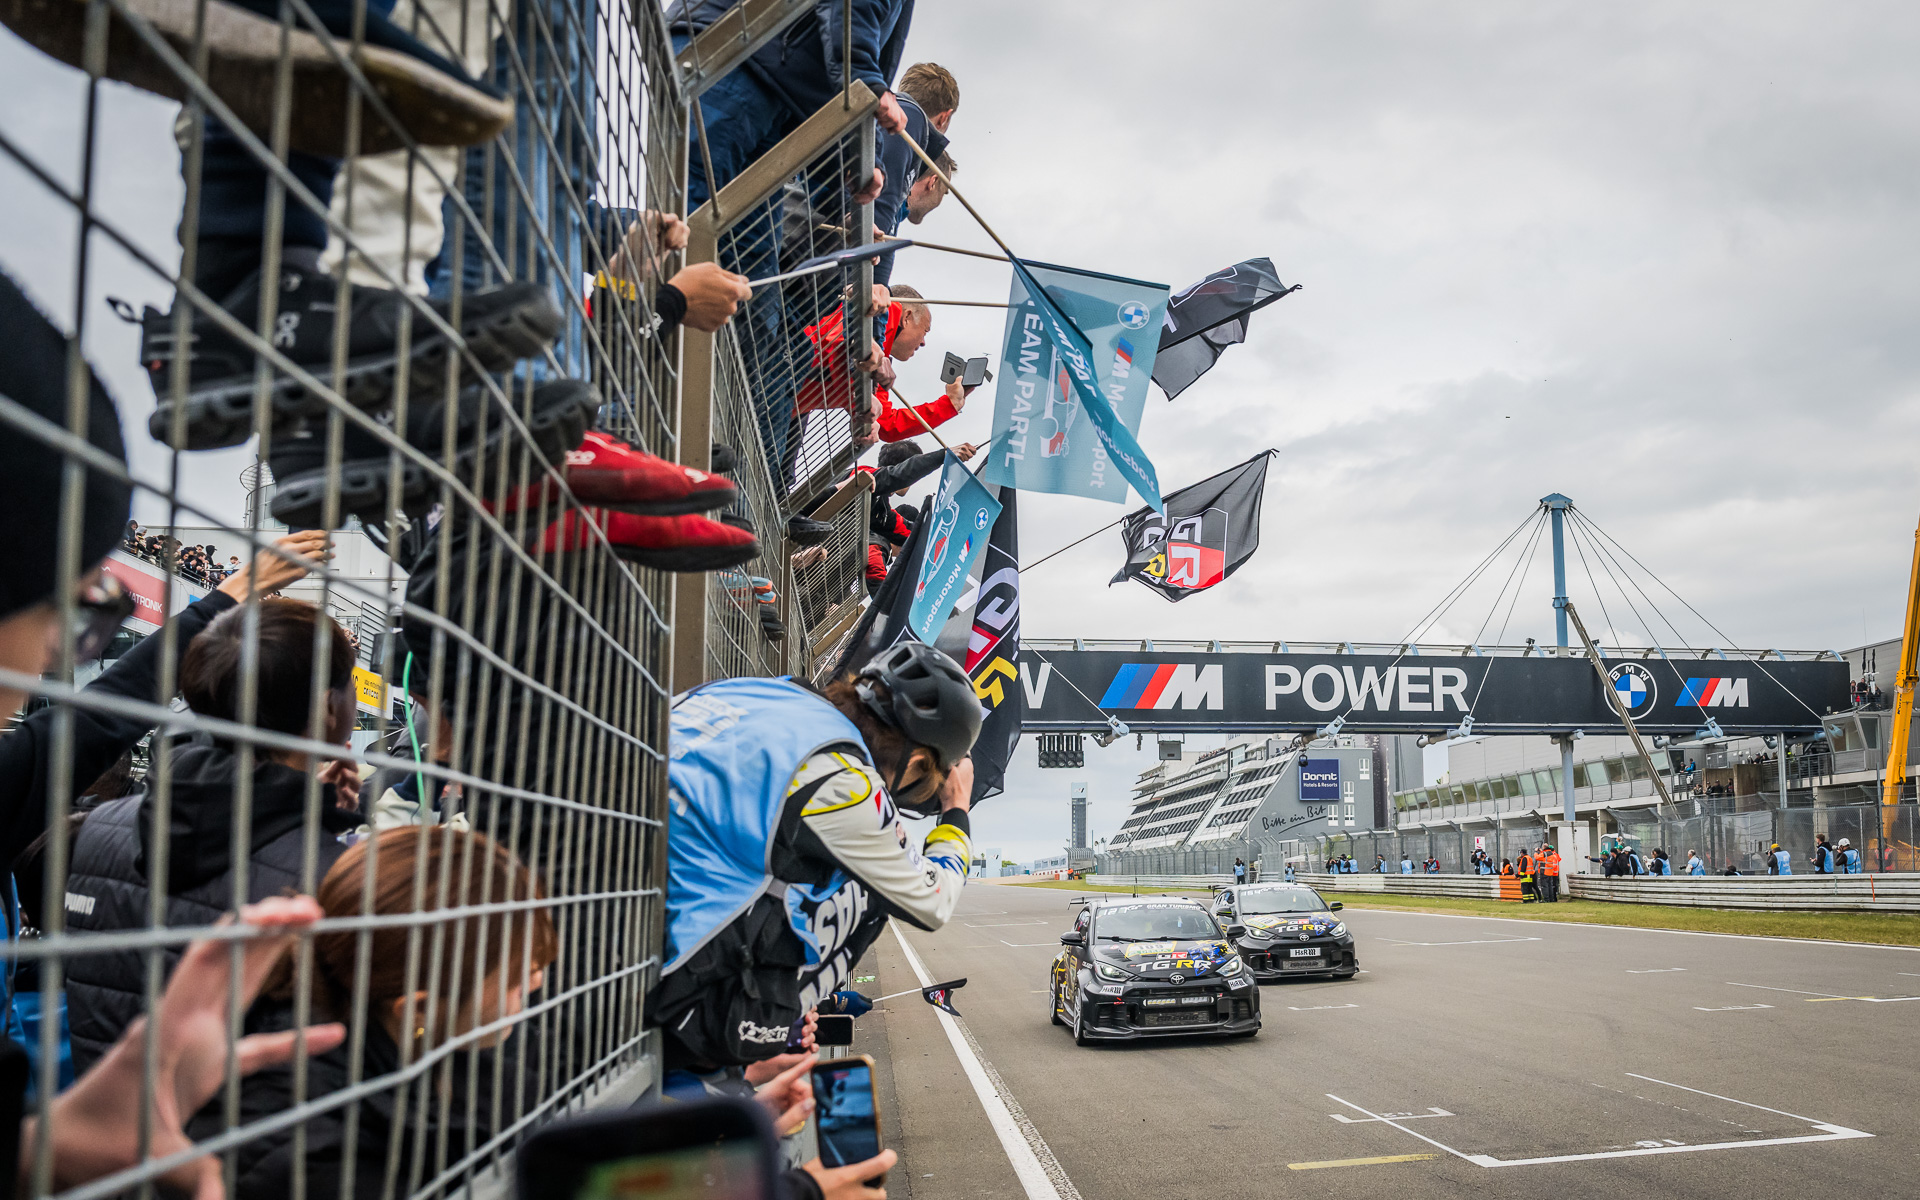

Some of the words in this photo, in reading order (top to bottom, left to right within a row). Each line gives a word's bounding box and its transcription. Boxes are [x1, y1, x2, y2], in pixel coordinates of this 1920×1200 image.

[1017, 299, 1044, 375] EAM
[1004, 379, 1036, 468] PARTL
[1170, 516, 1202, 588] GR
[921, 561, 962, 635] Motorsport
[1154, 664, 1224, 710] M
[1265, 664, 1468, 712] POWER
[1611, 665, 1650, 682] BMW
[1707, 678, 1749, 707] M
[1302, 772, 1338, 781] Dorint
[1262, 816, 1287, 830] Bitte
[1290, 814, 1305, 823] ein
[1307, 805, 1327, 818] Bit
[1136, 960, 1212, 972] TG-RR
[1157, 952, 1188, 960] GR
